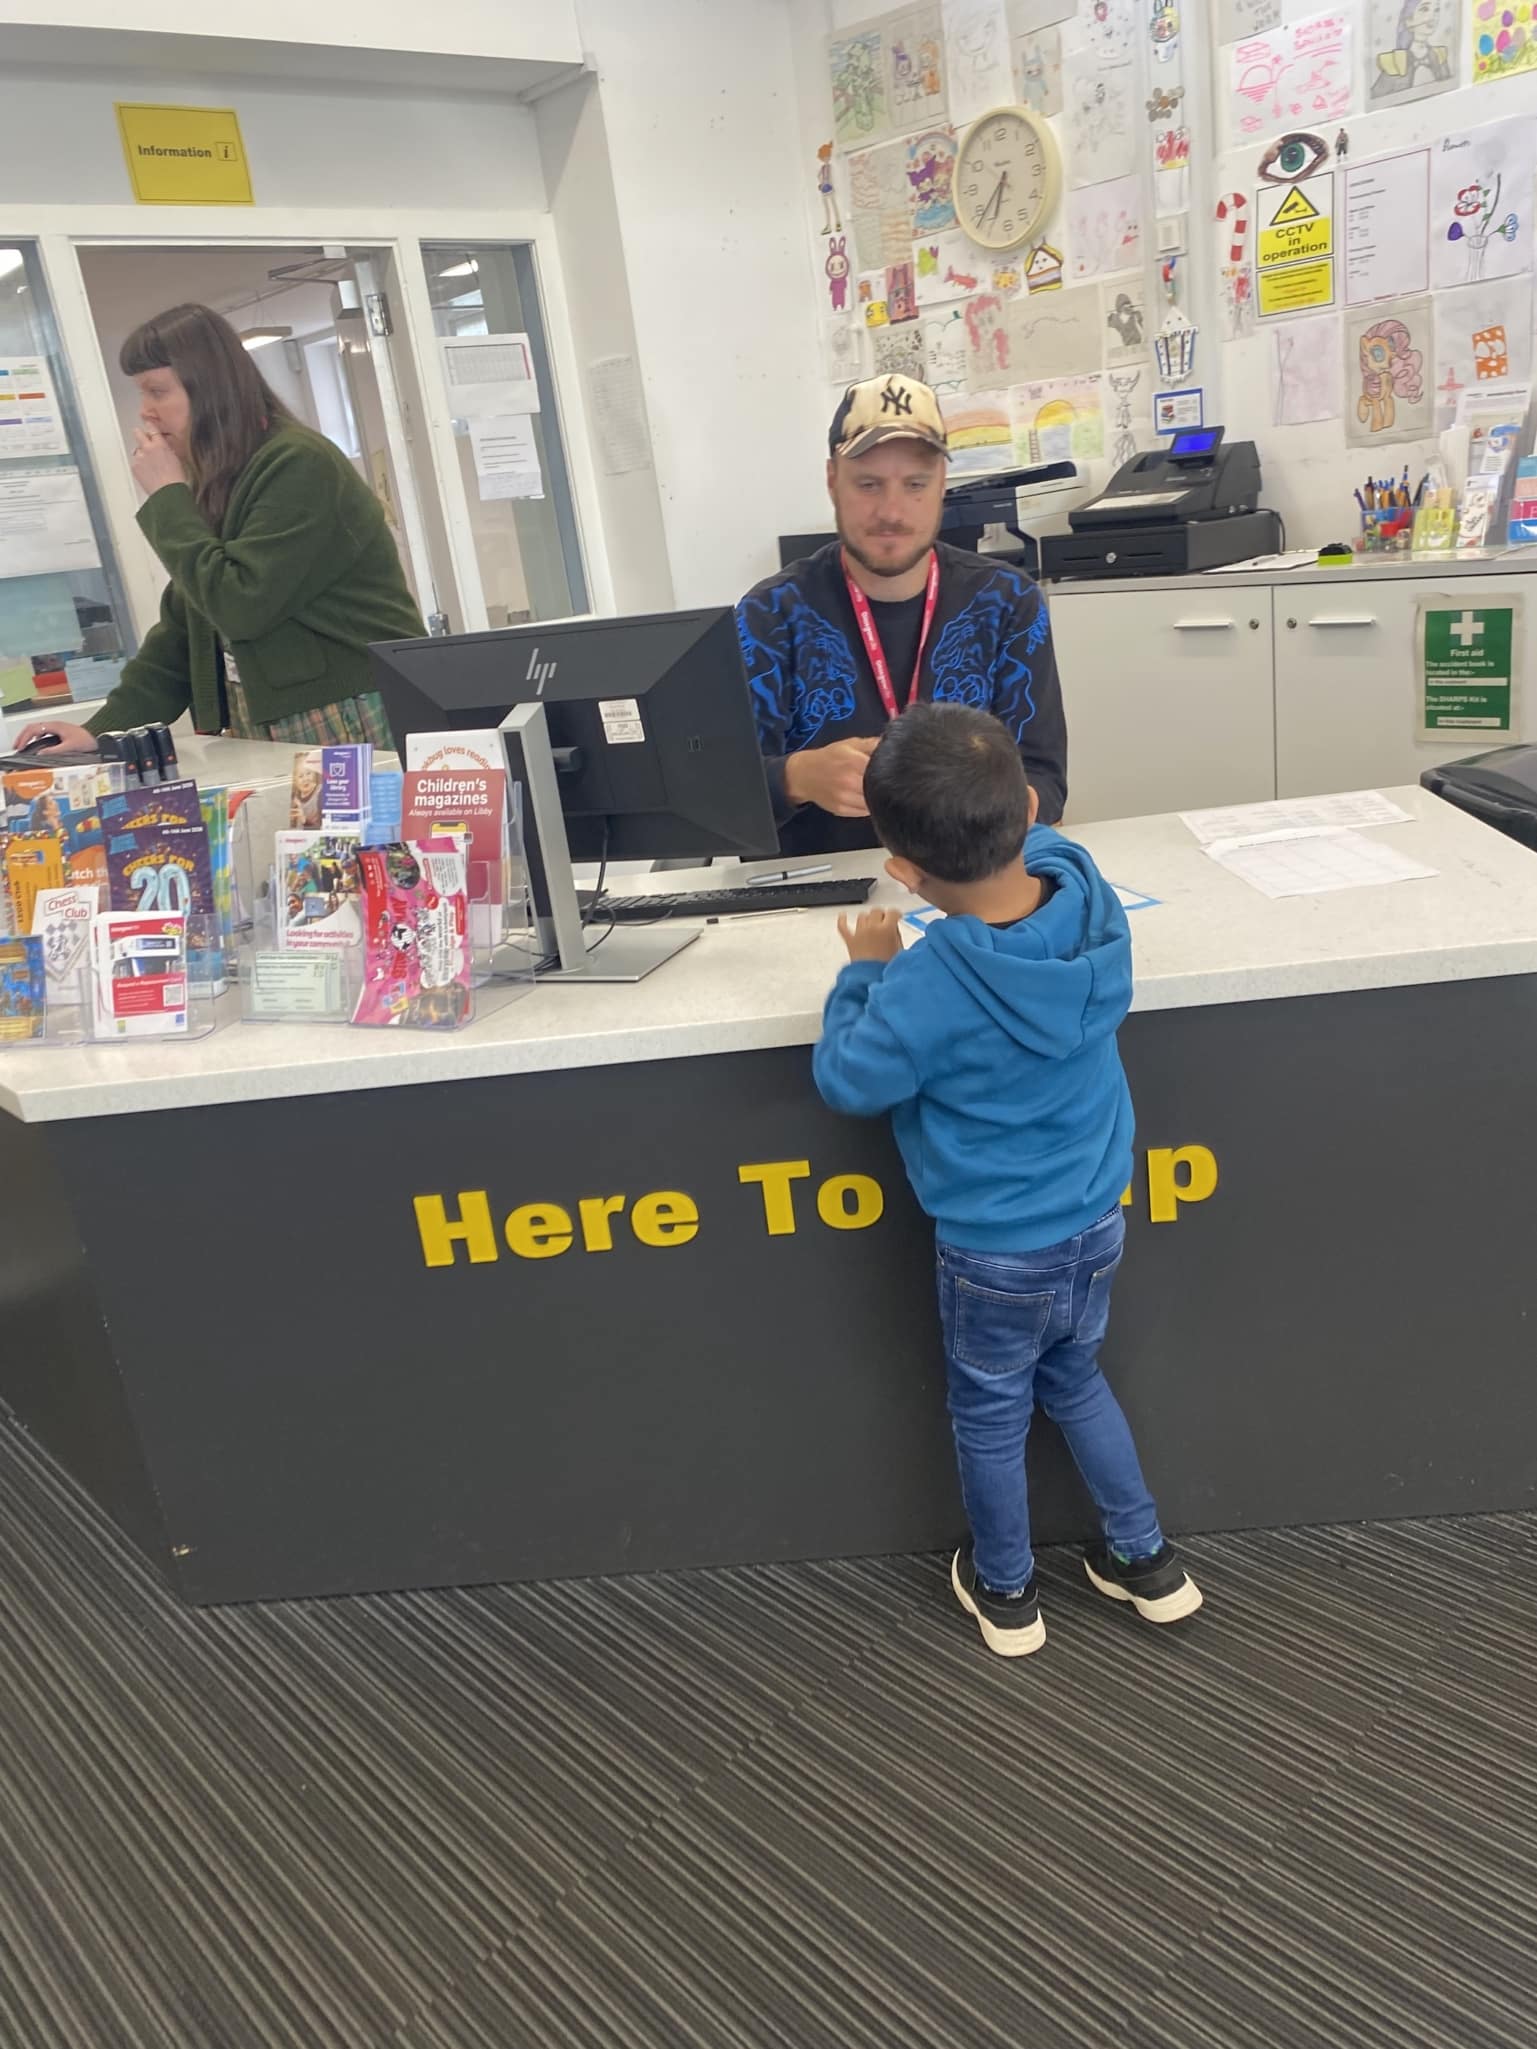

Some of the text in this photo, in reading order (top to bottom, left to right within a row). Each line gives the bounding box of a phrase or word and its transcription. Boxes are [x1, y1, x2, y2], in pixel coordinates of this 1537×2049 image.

[138, 146, 212, 158] Information
[1275, 222, 1315, 239] CCTV
[1288, 236, 1302, 247] in
[1262, 241, 1328, 262] operation
[881, 387, 912, 415] NY
[1450, 648, 1484, 657] First aid
[526, 648, 557, 695] hp
[443, 745, 465, 755] loves
[416, 778, 487, 792] Children's
[414, 792, 488, 808] magazines
[408, 809, 432, 818] Always
[433, 808, 462, 816] available
[473, 807, 493, 816] Libby
[168, 854, 195, 872] FOR
[130, 863, 192, 917] 20
[48, 895, 76, 911] Chess
[65, 908, 88, 918] Club
[413, 1159, 884, 1267] Here To
